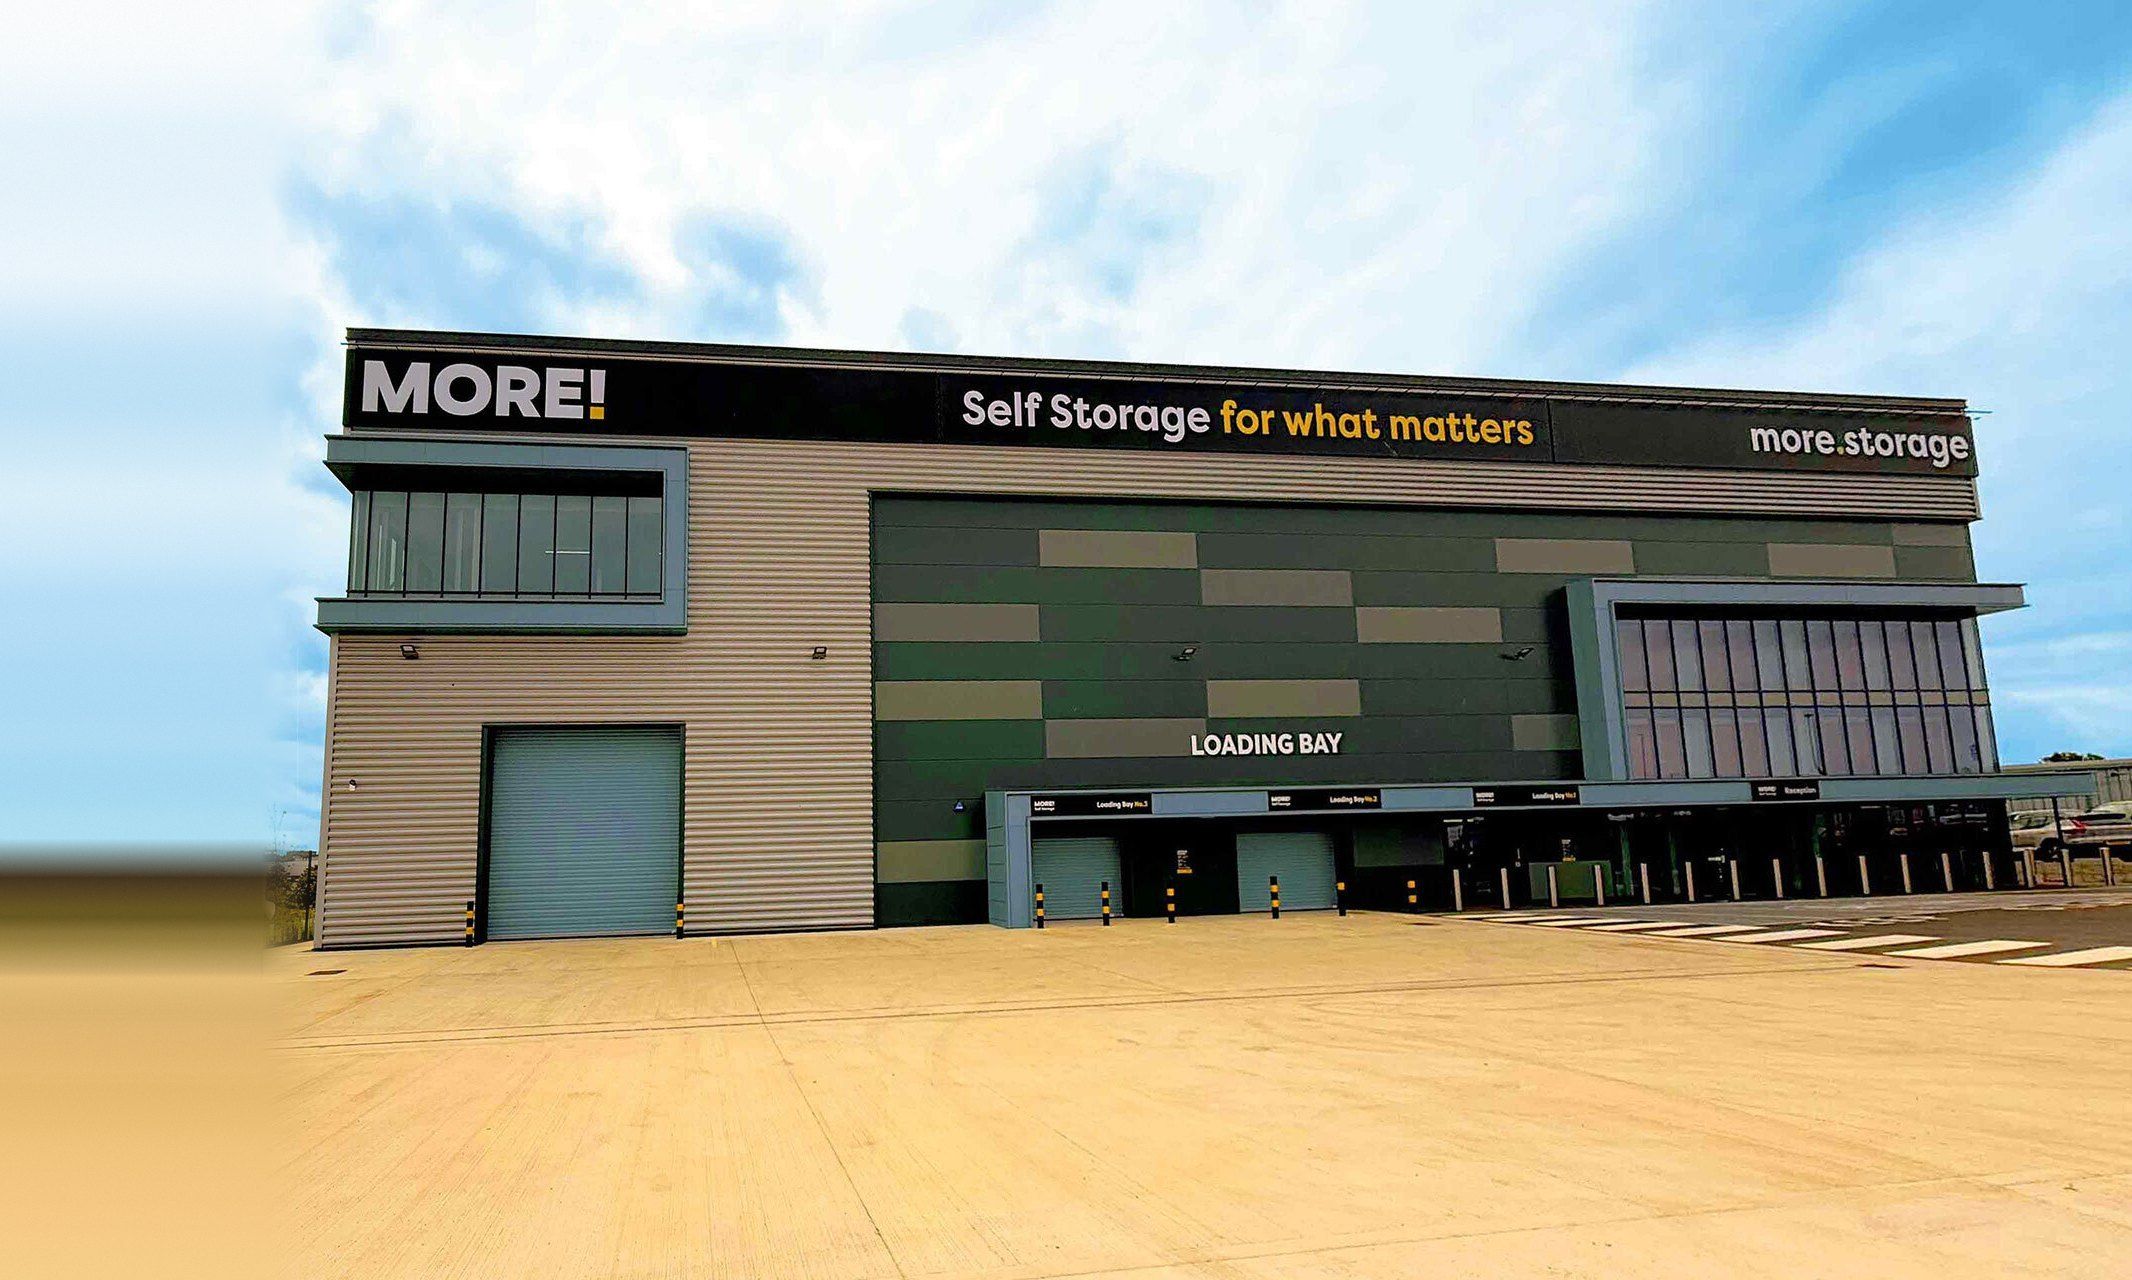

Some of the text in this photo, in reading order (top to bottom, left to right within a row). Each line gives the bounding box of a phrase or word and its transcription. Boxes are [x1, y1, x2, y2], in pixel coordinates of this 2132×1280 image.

[361, 360, 606, 420] MORE!
[962, 390, 1534, 445] Self Storage for what matters
[1750, 427, 1969, 468] more.storage
[1190, 733, 1343, 756] LOADING BAY
[1096, 801, 1121, 809] Loading
[1122, 801, 1134, 809] Bay
